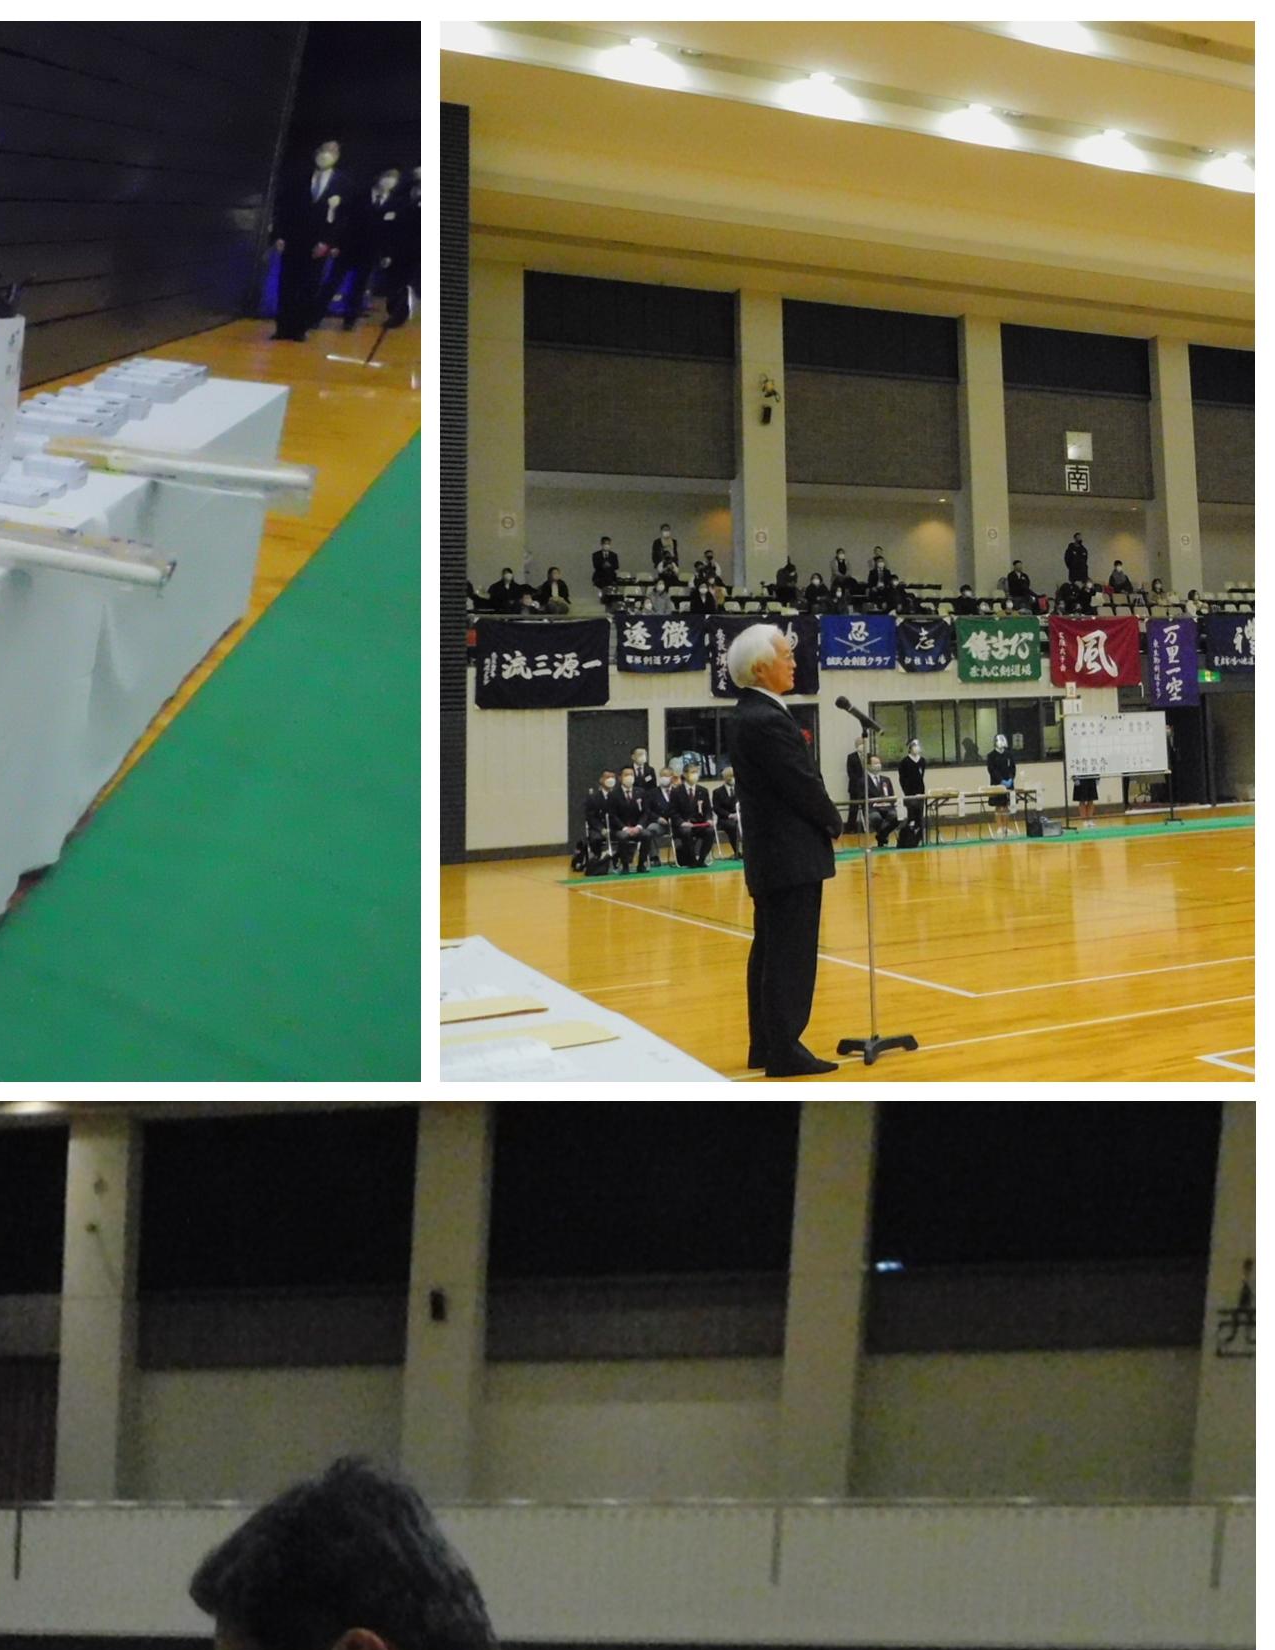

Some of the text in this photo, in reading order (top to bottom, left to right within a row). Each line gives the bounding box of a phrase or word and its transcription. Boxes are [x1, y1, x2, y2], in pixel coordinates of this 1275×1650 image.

[1066, 465, 1089, 491] 南
[623, 620, 692, 650] 透徹
[849, 621, 869, 642] 忍
[915, 627, 935, 650] 志
[1075, 629, 1118, 678] 風
[1163, 624, 1183, 701] 万里一空
